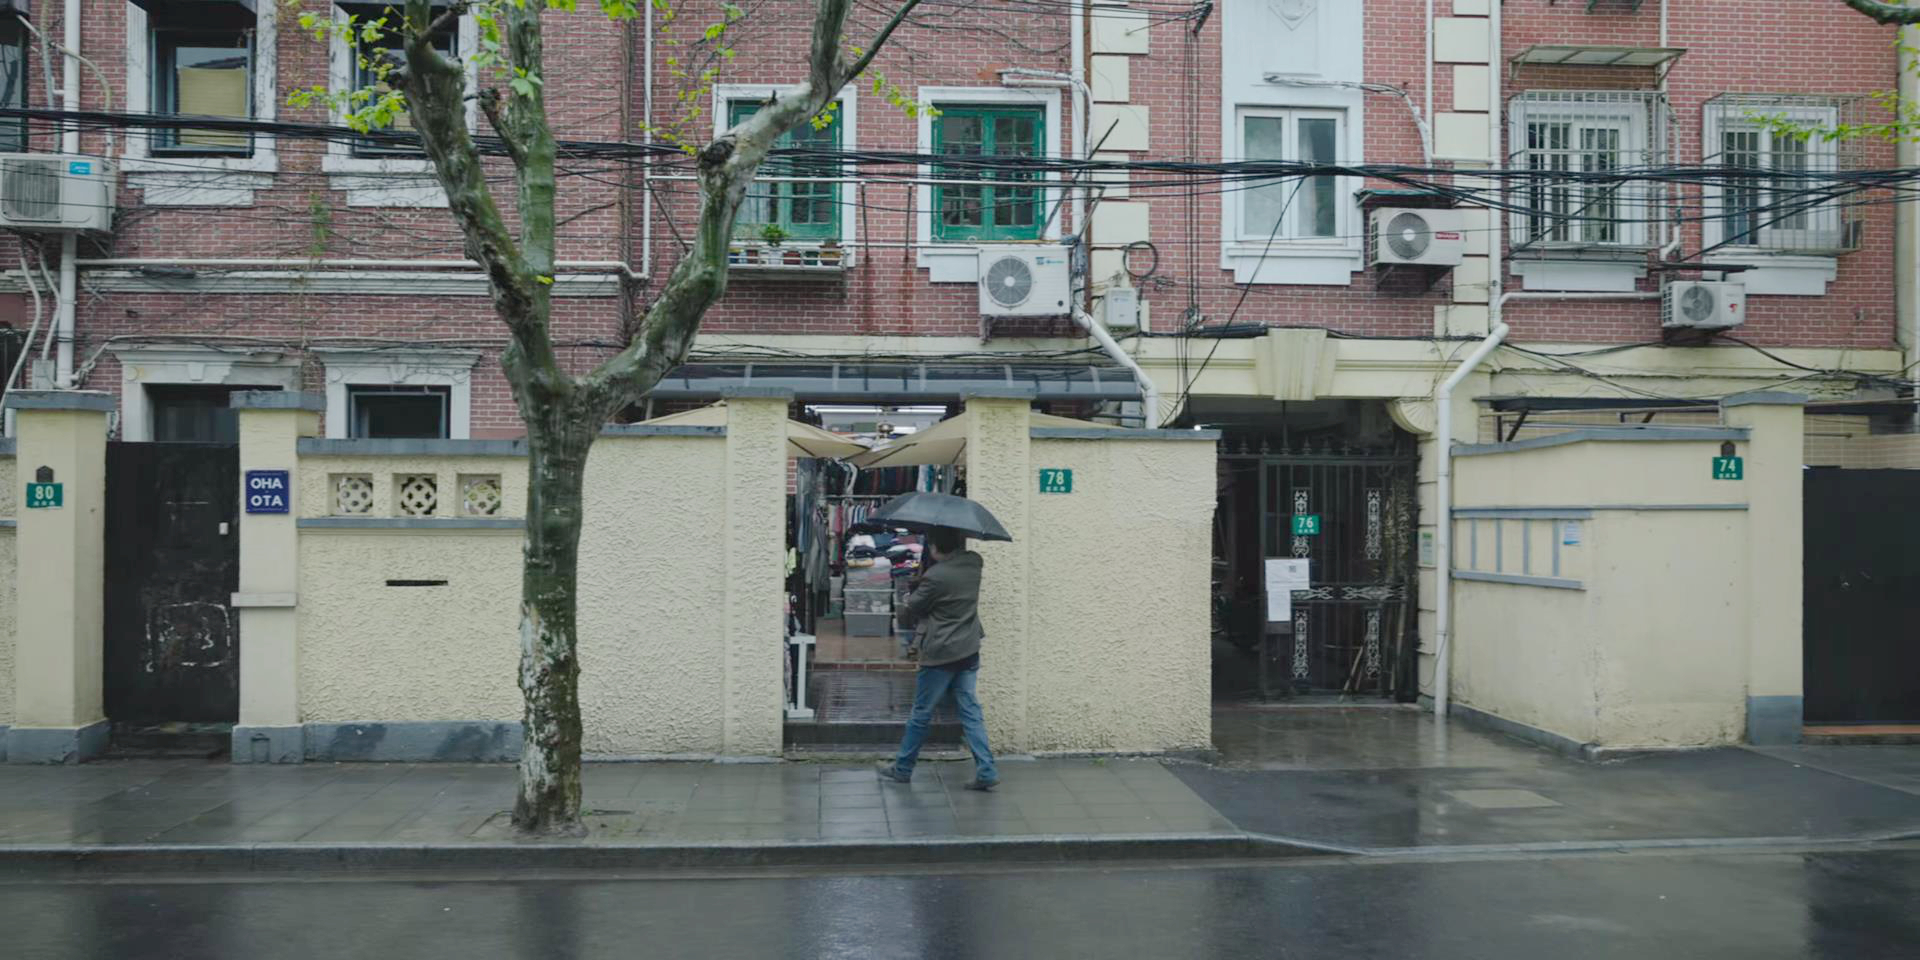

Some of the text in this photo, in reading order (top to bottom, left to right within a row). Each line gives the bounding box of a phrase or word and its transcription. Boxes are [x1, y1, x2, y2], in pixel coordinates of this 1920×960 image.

[1720, 459, 1736, 472] 74
[250, 477, 283, 489] OHA
[1047, 471, 1064, 485] 78
[35, 485, 54, 500] 80
[250, 495, 283, 506] OTA
[1298, 517, 1314, 528] 76
